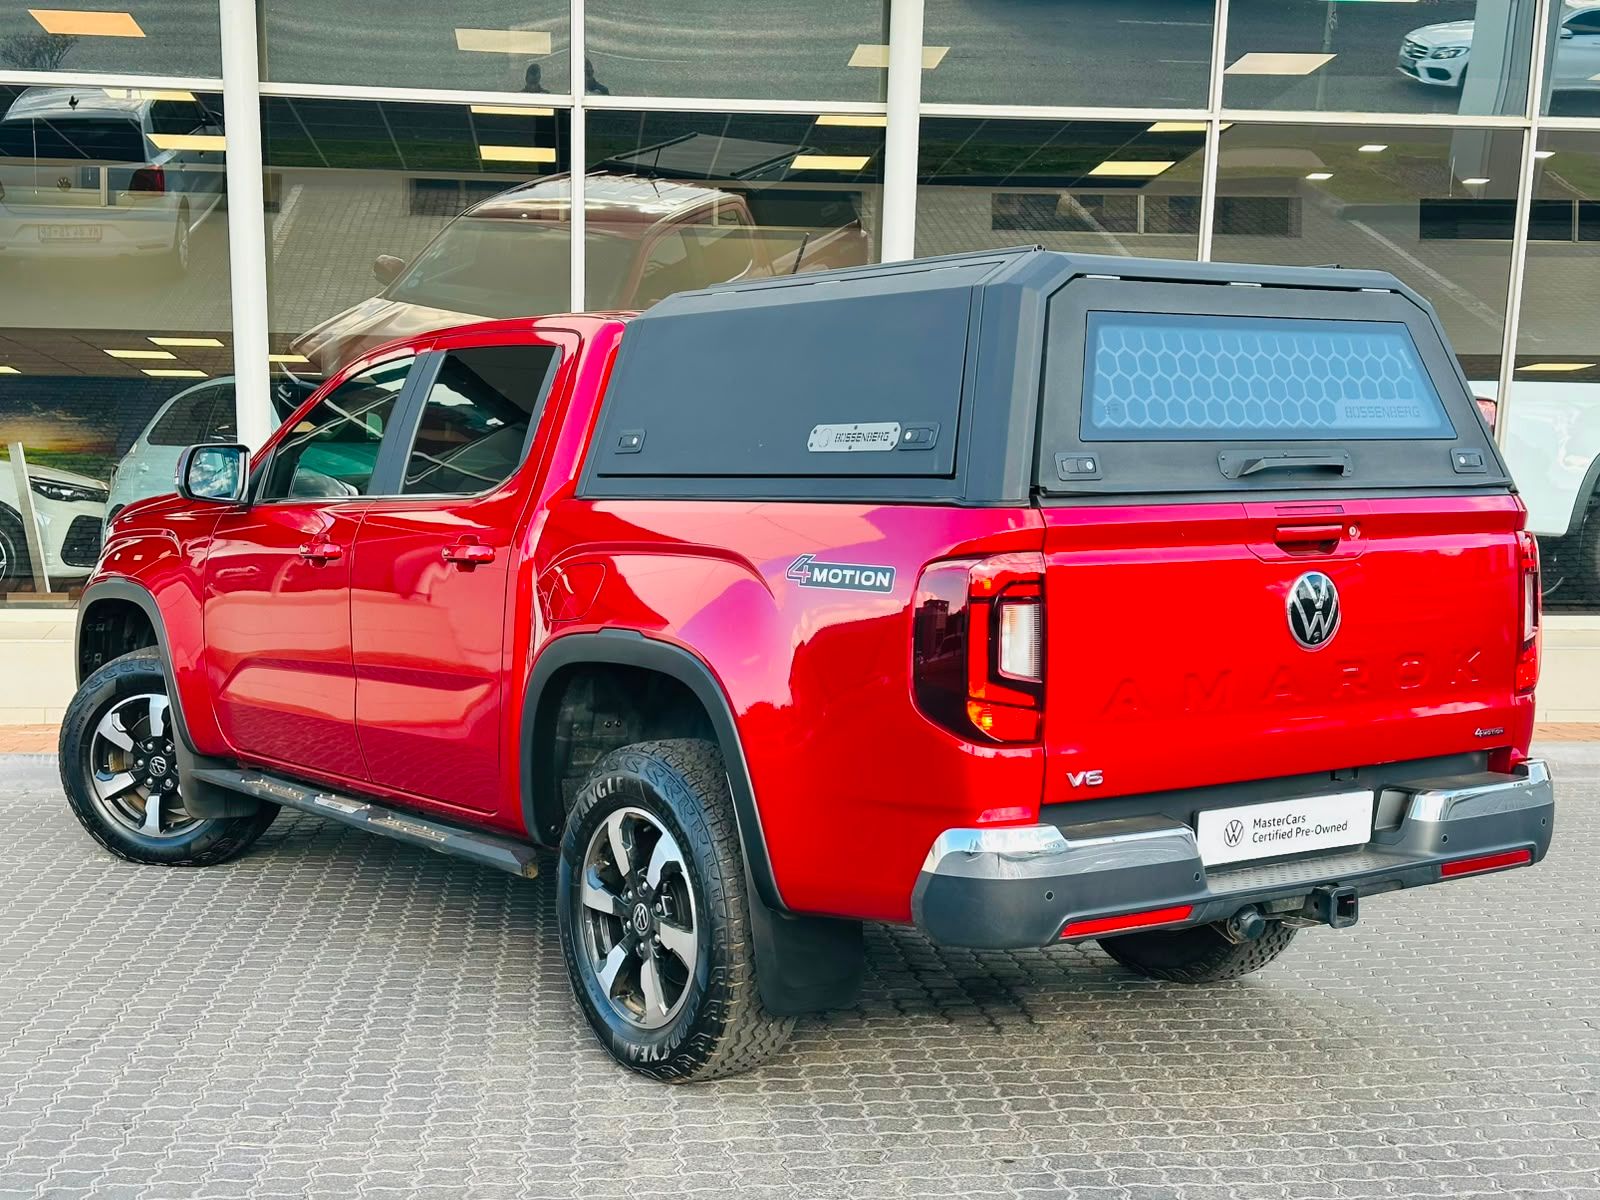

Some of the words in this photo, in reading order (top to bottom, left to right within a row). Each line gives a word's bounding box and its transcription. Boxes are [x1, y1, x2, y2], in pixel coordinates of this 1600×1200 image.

[785, 553, 893, 588] 4MOTION
[1097, 647, 1483, 721] AMAROK
[1065, 769, 1104, 788] V6
[1251, 828, 1293, 844] Certified
[1294, 819, 1348, 839] Pre-Owned
[1252, 813, 1306, 830] MasterCars
